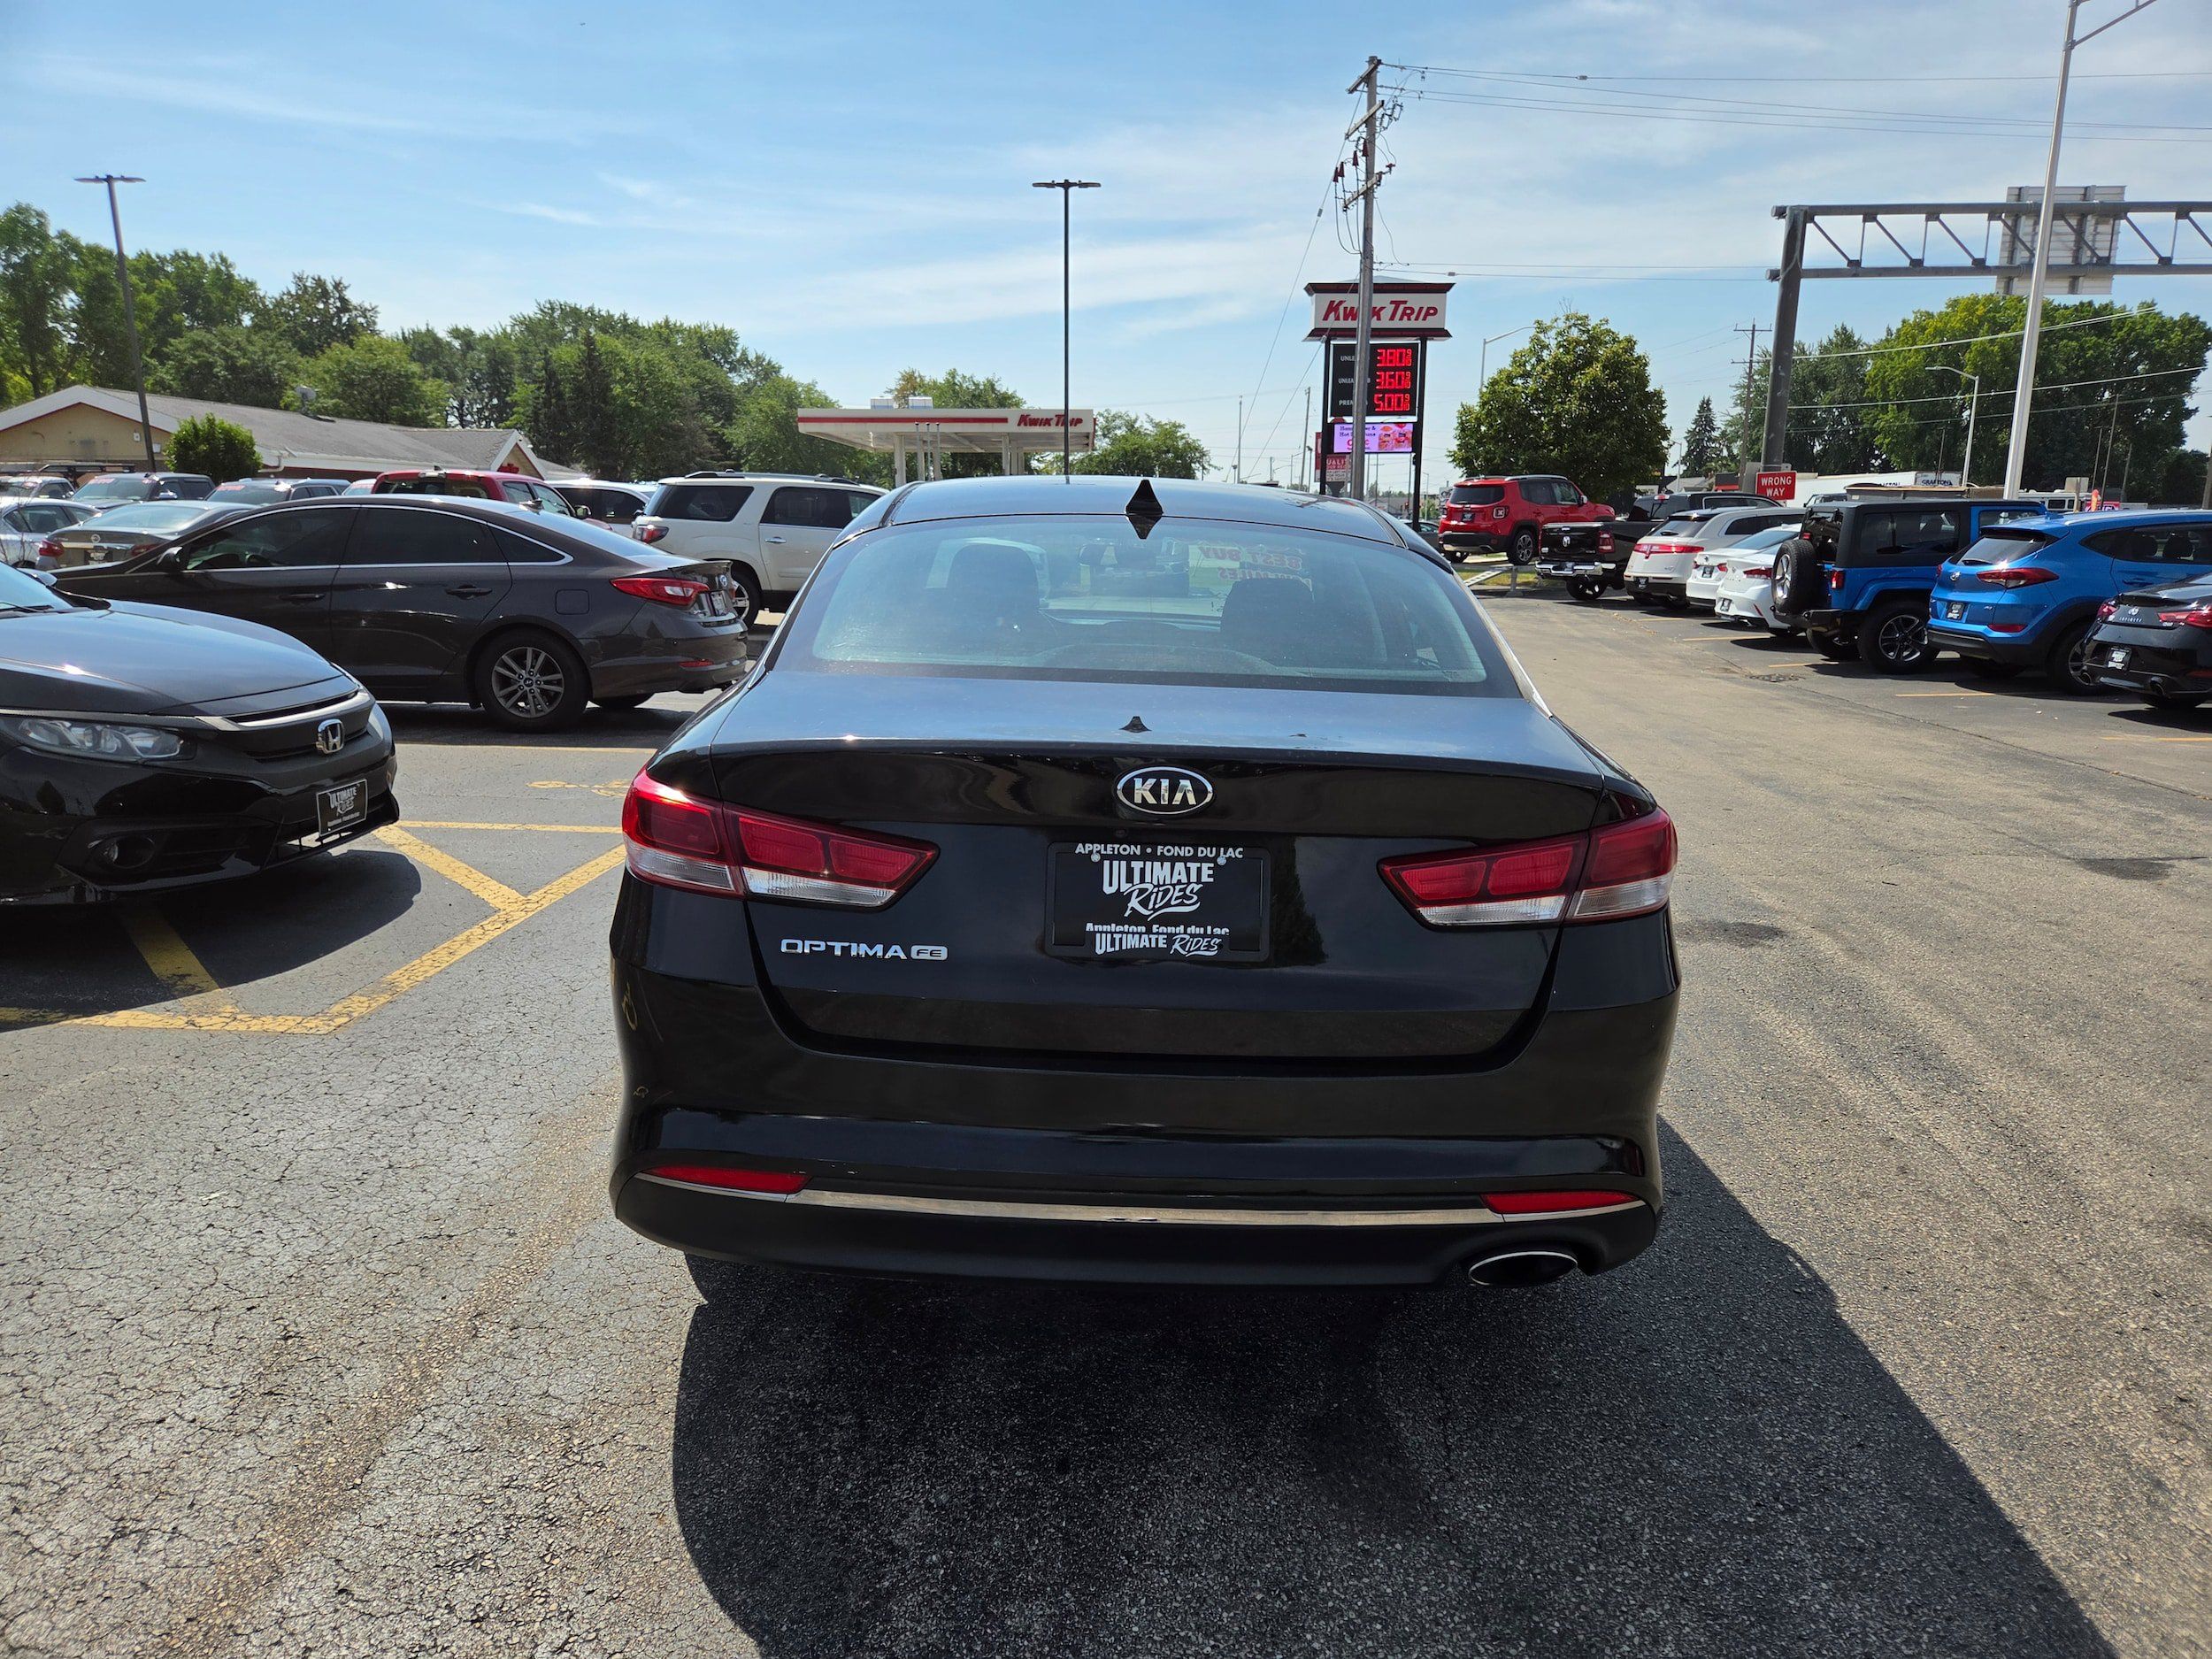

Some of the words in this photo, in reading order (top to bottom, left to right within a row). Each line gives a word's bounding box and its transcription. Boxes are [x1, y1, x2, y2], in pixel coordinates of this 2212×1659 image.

[1322, 300, 1386, 321] KWK
[1388, 300, 1439, 321] TRIP
[1017, 414, 1054, 426] KWIK
[1761, 476, 1793, 487] WRONG
[1766, 487, 1786, 497] WAY
[1133, 778, 1197, 805] KIA
[1074, 842, 1141, 856] APPLETON
[1156, 845, 1194, 857] FOND
[1197, 846, 1216, 857] DU
[1219, 847, 1243, 858] LAC
[1102, 860, 1214, 895] ULTIMATE
[1153, 924, 1185, 933] Fond
[1187, 925, 1205, 934] du
[780, 938, 908, 960] OPTIMA
[1094, 933, 1167, 956] ULTIMATE
